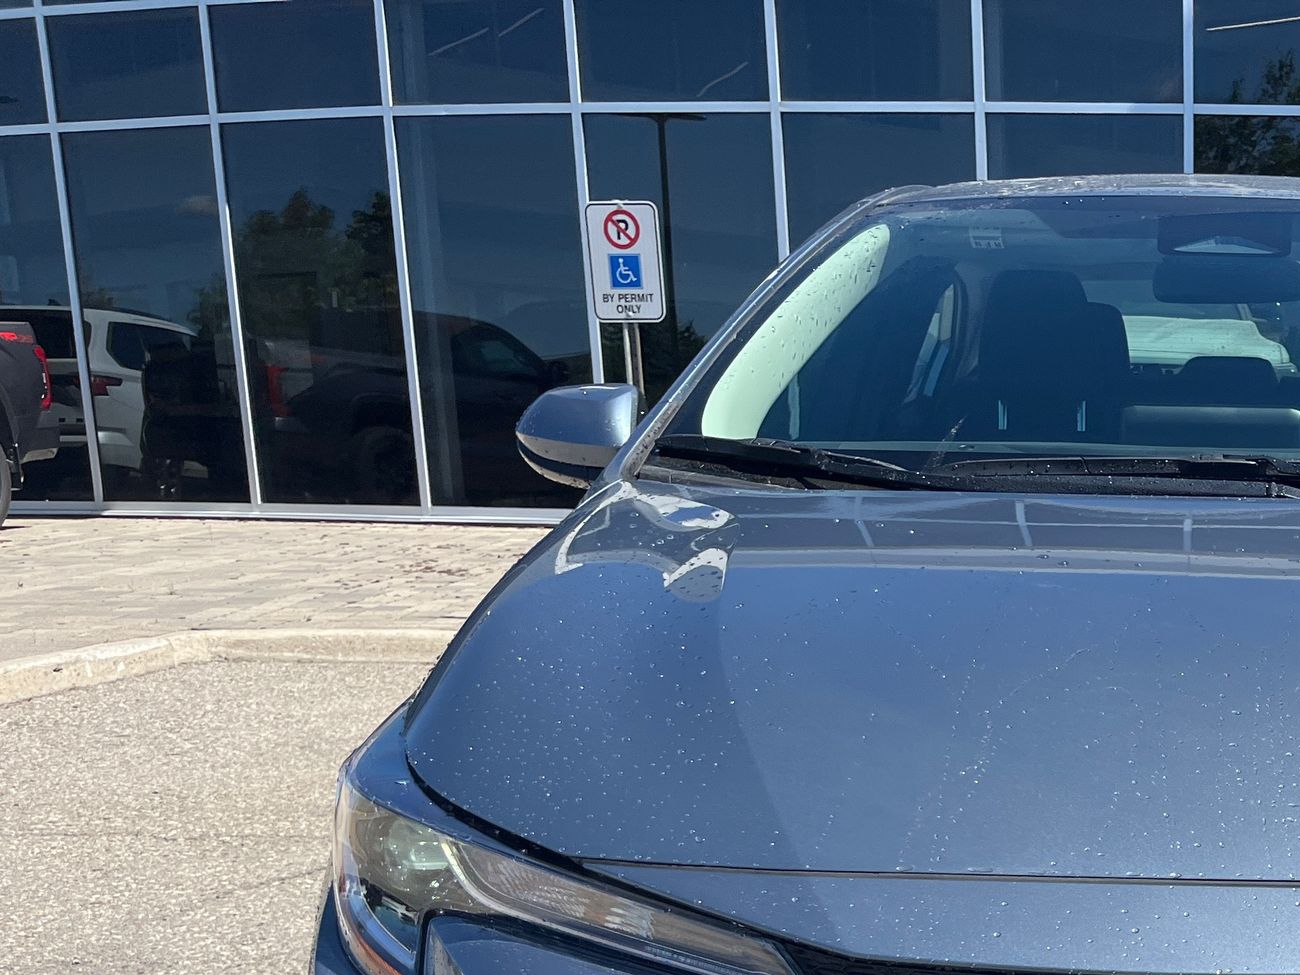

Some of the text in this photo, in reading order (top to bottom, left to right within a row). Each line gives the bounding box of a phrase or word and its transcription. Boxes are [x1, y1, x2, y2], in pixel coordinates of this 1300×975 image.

[602, 294, 654, 303] BY PERMIT
[616, 305, 641, 314] ONLY
